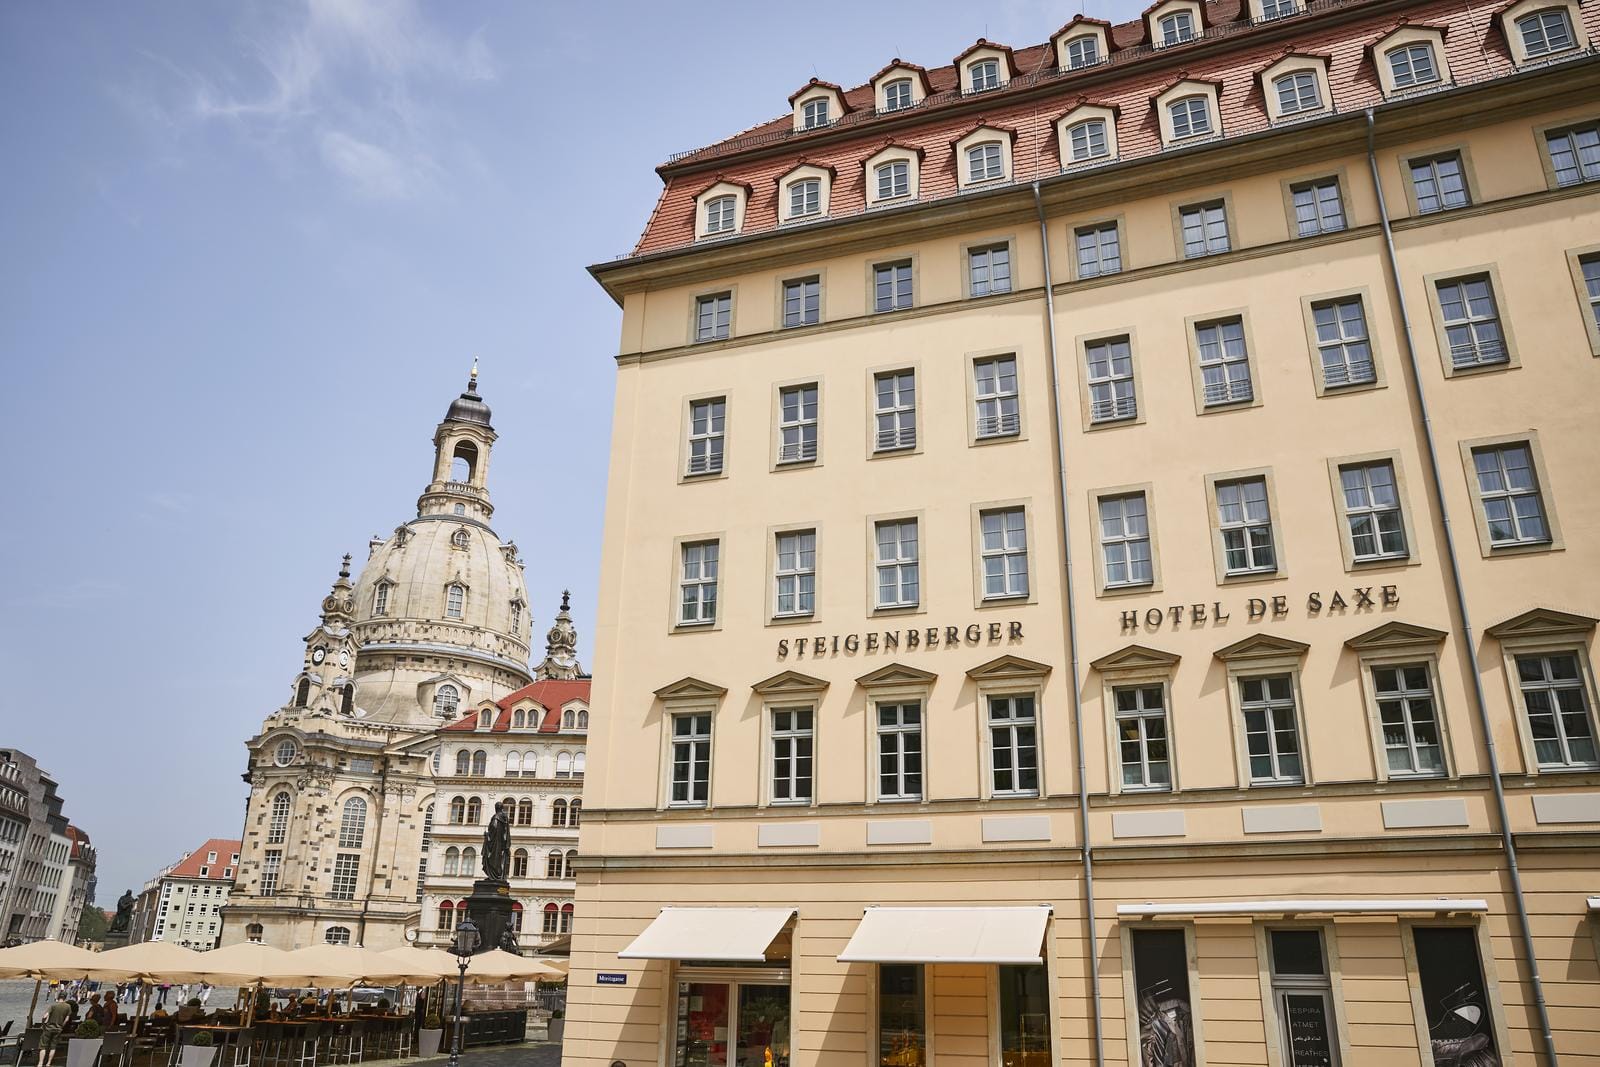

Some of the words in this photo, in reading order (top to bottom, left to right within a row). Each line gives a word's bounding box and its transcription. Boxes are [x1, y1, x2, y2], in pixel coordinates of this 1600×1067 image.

[1121, 602, 1230, 629] HOTEL
[1248, 595, 1289, 619] DE
[1308, 585, 1400, 613] SAXE
[778, 621, 1024, 656] STEIGENBERGER
